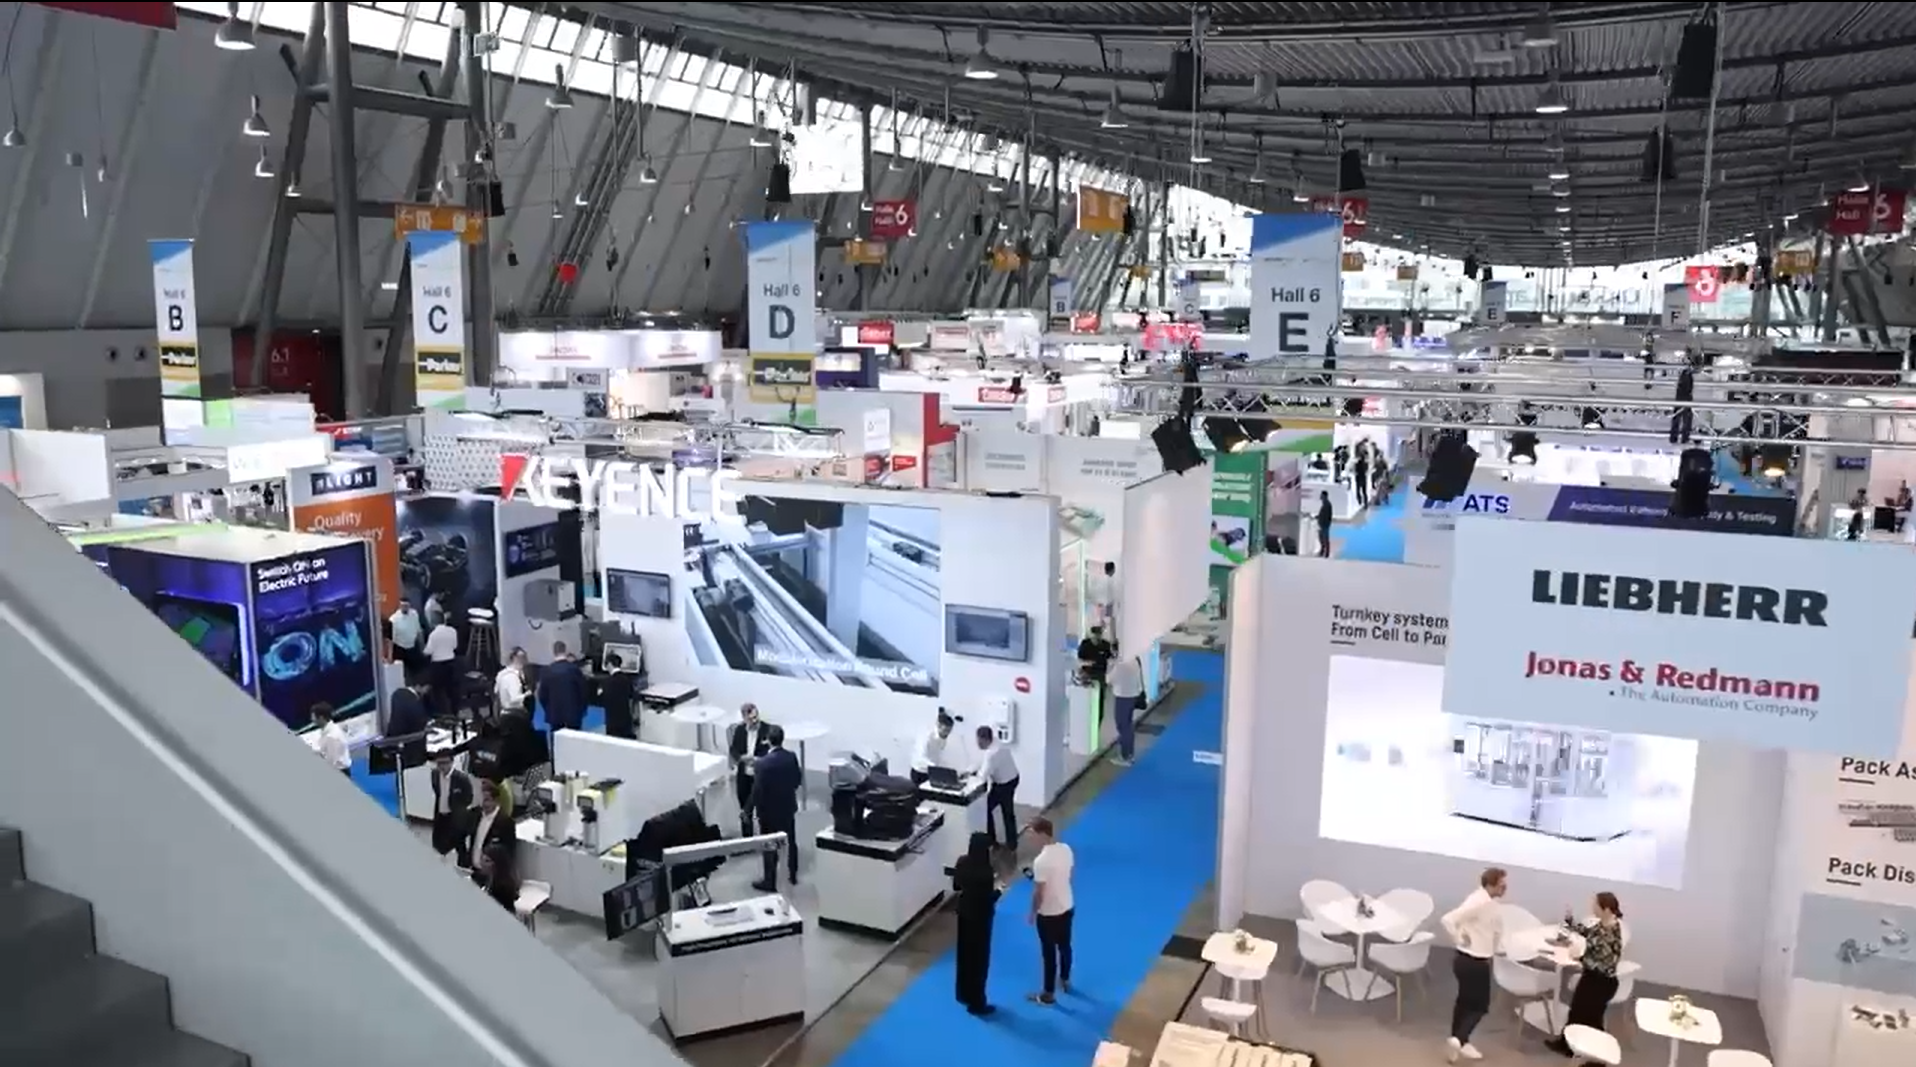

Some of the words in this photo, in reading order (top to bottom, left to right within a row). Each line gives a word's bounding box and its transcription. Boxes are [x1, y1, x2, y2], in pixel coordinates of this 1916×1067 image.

[895, 204, 908, 225] 6
[1342, 201, 1355, 225] 6
[1874, 193, 1891, 220] 6
[444, 286, 452, 298] 6
[763, 284, 788, 298] Hall
[792, 284, 801, 297] 6
[1271, 287, 1305, 302] Hall
[1310, 288, 1321, 302] 6
[168, 305, 184, 331] B
[428, 305, 448, 334] C
[769, 304, 795, 339] D
[1279, 312, 1309, 352] E
[272, 347, 289, 363] 6.1
[500, 453, 747, 525] KEYENCE
[1463, 494, 1509, 514] ATS
[314, 511, 362, 528] Quality
[260, 575, 297, 593] Electric
[299, 570, 329, 585] Future
[1532, 569, 1828, 627] LIEBHERR
[1331, 604, 1390, 625] Turnkey
[1331, 621, 1367, 639] From
[1372, 625, 1400, 642] Cell
[1404, 629, 1419, 643] to
[262, 620, 365, 680] ON
[900, 666, 928, 681] Cell
[1525, 651, 1612, 680] Jonas
[1620, 660, 1645, 684] &
[1656, 663, 1820, 702] Redmann
[1619, 685, 1648, 701] The
[1650, 688, 1739, 712] Automation
[1743, 699, 1819, 722] Company
[1841, 757, 1891, 777] Pack
[1828, 857, 1878, 878] Pack
[1884, 864, 1915, 884] Dis
